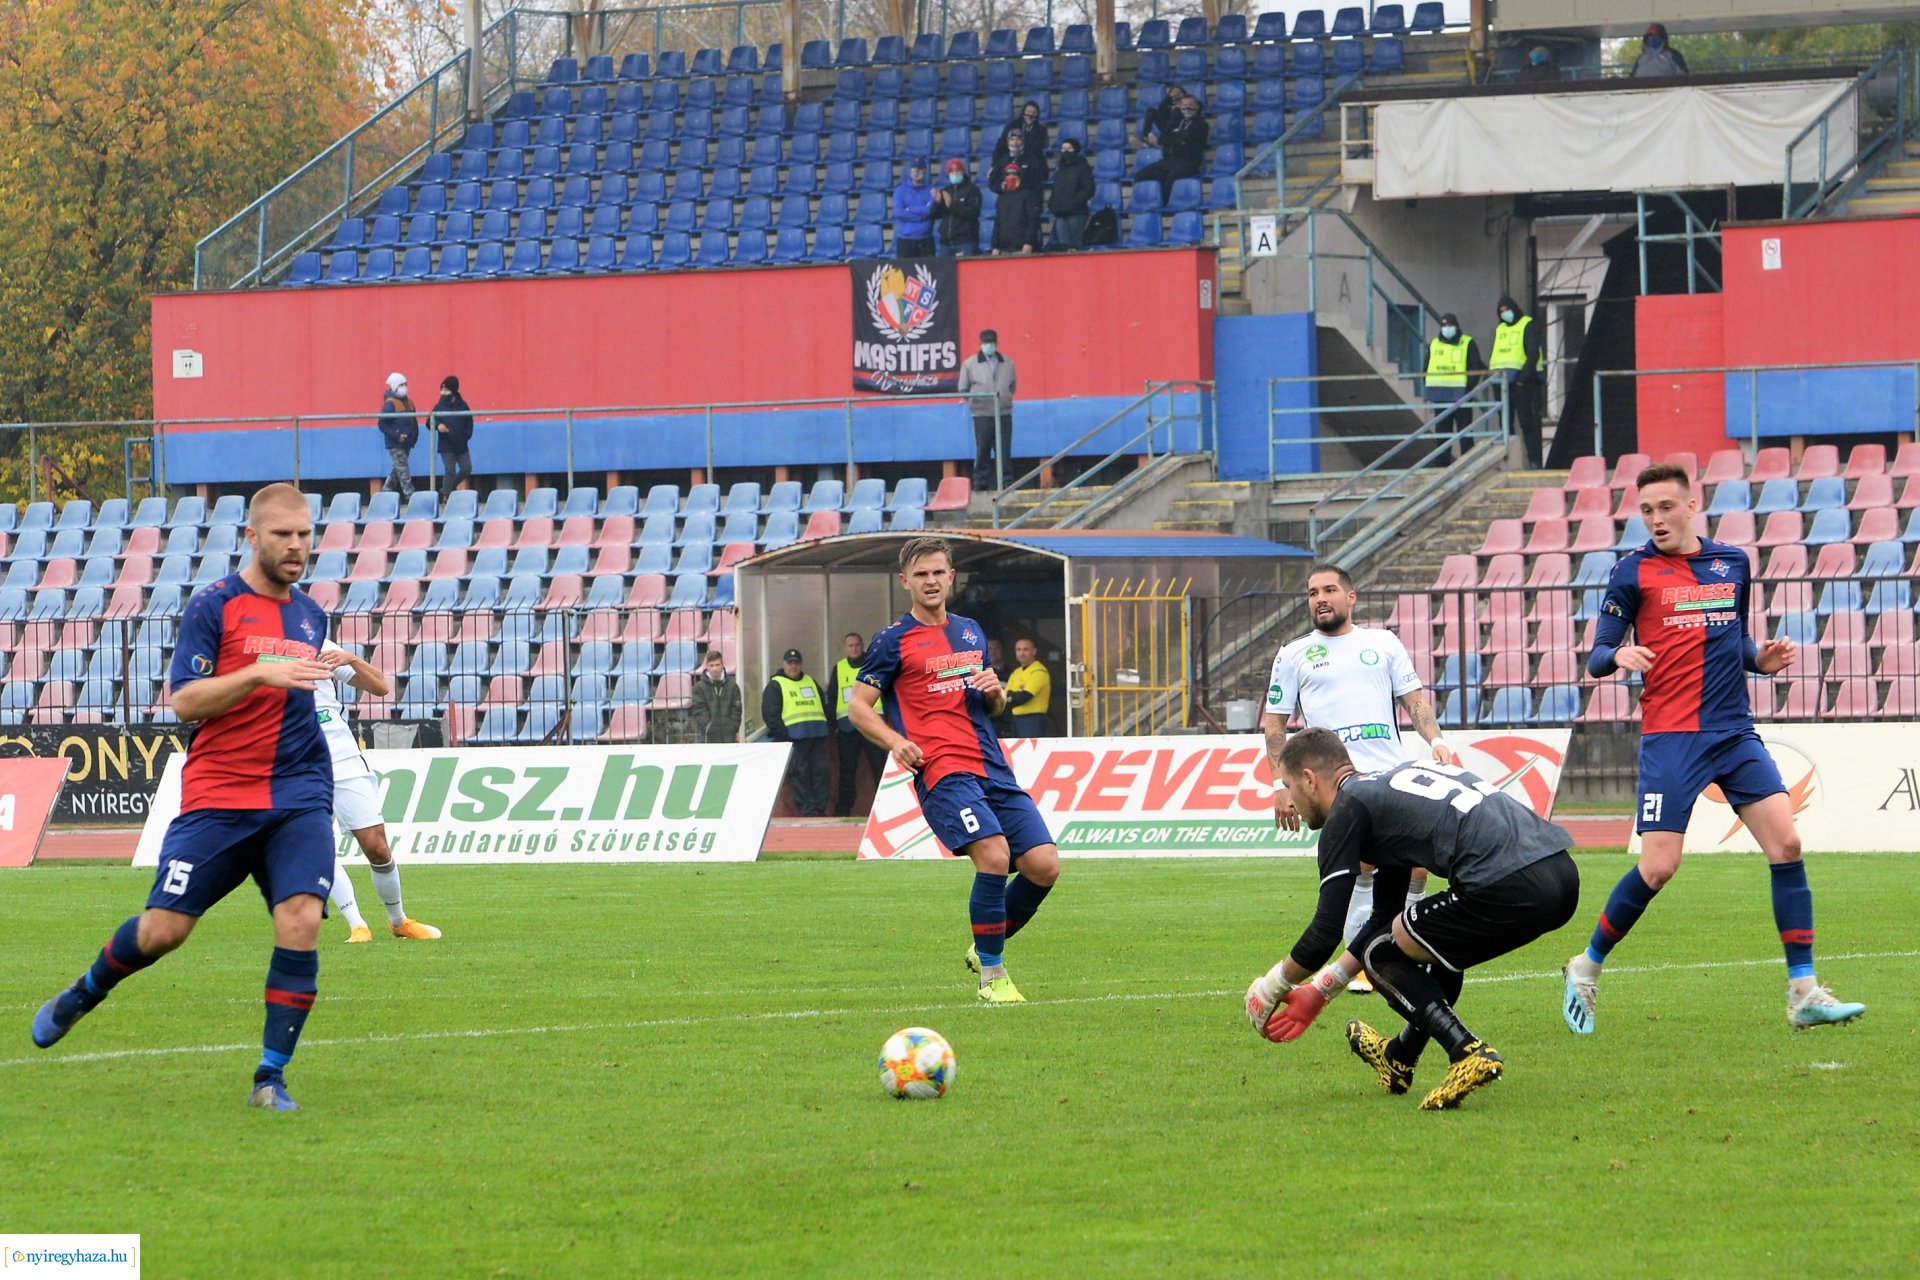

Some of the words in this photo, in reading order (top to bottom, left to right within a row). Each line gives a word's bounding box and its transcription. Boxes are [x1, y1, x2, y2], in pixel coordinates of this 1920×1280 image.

[1258, 232, 1272, 251] A
[920, 290, 932, 306] S
[912, 308, 923, 322] C
[854, 340, 957, 372] MASTIFFS
[1661, 582, 1736, 606] REVESZ
[925, 650, 984, 674] REVESZ
[1643, 793, 1663, 822] 21
[959, 807, 980, 834] 6
[410, 828, 558, 856] Labdarúgó
[571, 827, 717, 854] Szövetség
[1060, 828, 1141, 844] ALWAYS
[1141, 827, 1173, 843] ON
[1174, 826, 1212, 843] THE
[1211, 826, 1275, 843] RIGHT
[163, 859, 193, 896] 15
